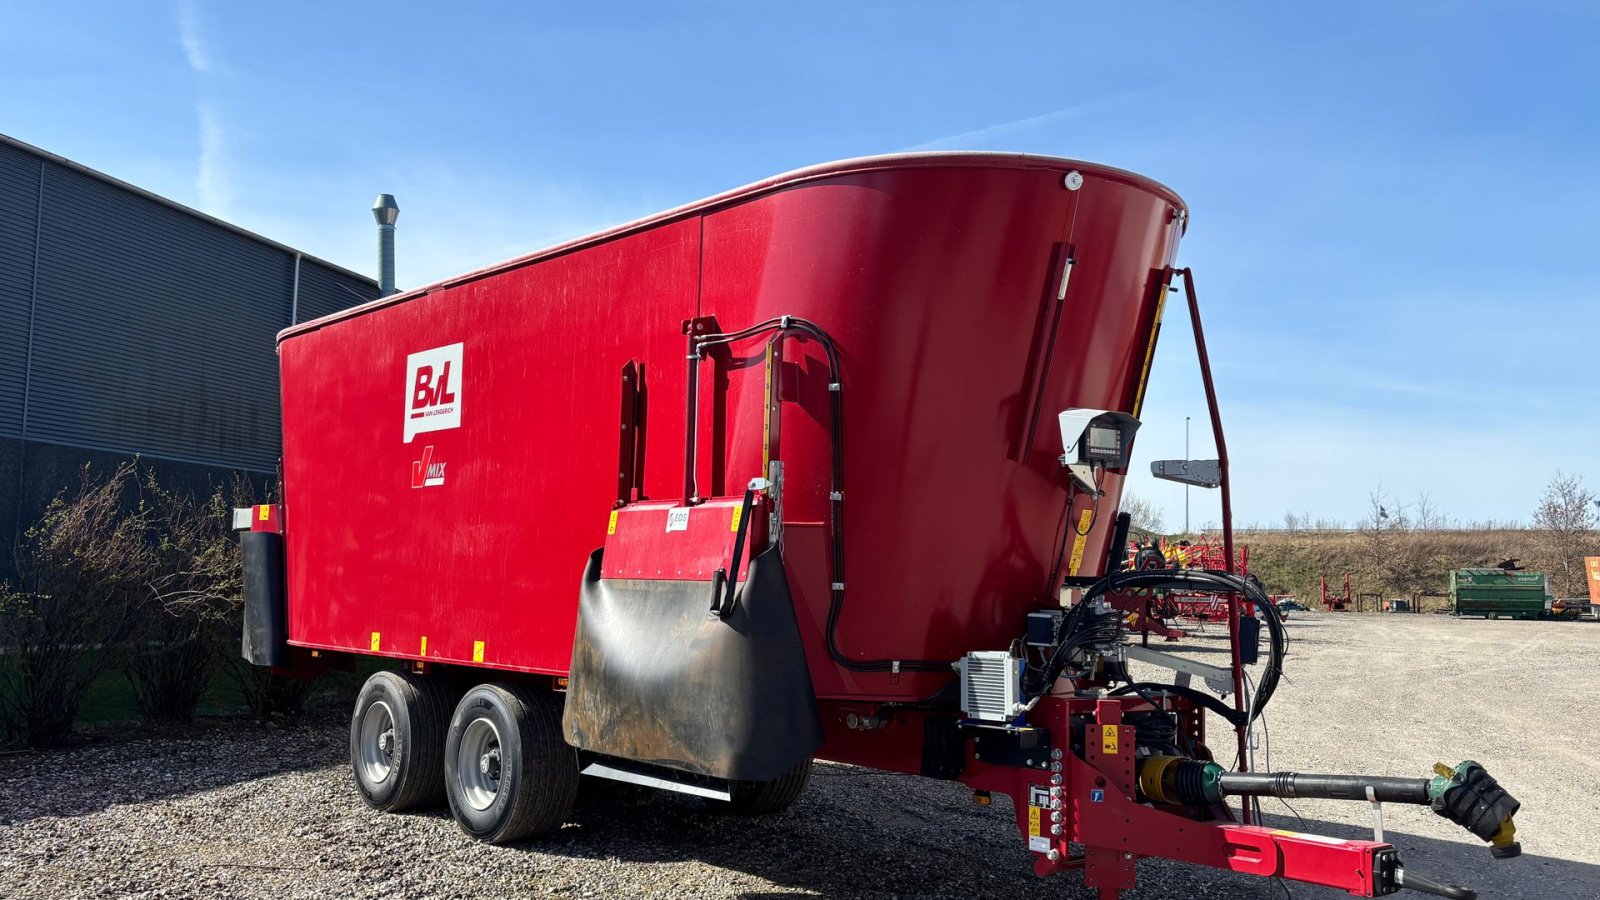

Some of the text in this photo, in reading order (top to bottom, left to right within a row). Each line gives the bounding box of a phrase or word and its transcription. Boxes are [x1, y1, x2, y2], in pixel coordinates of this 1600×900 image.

[433, 407, 454, 416] LENGERICH
[427, 462, 447, 478] MIX
[675, 513, 687, 522] EDS
